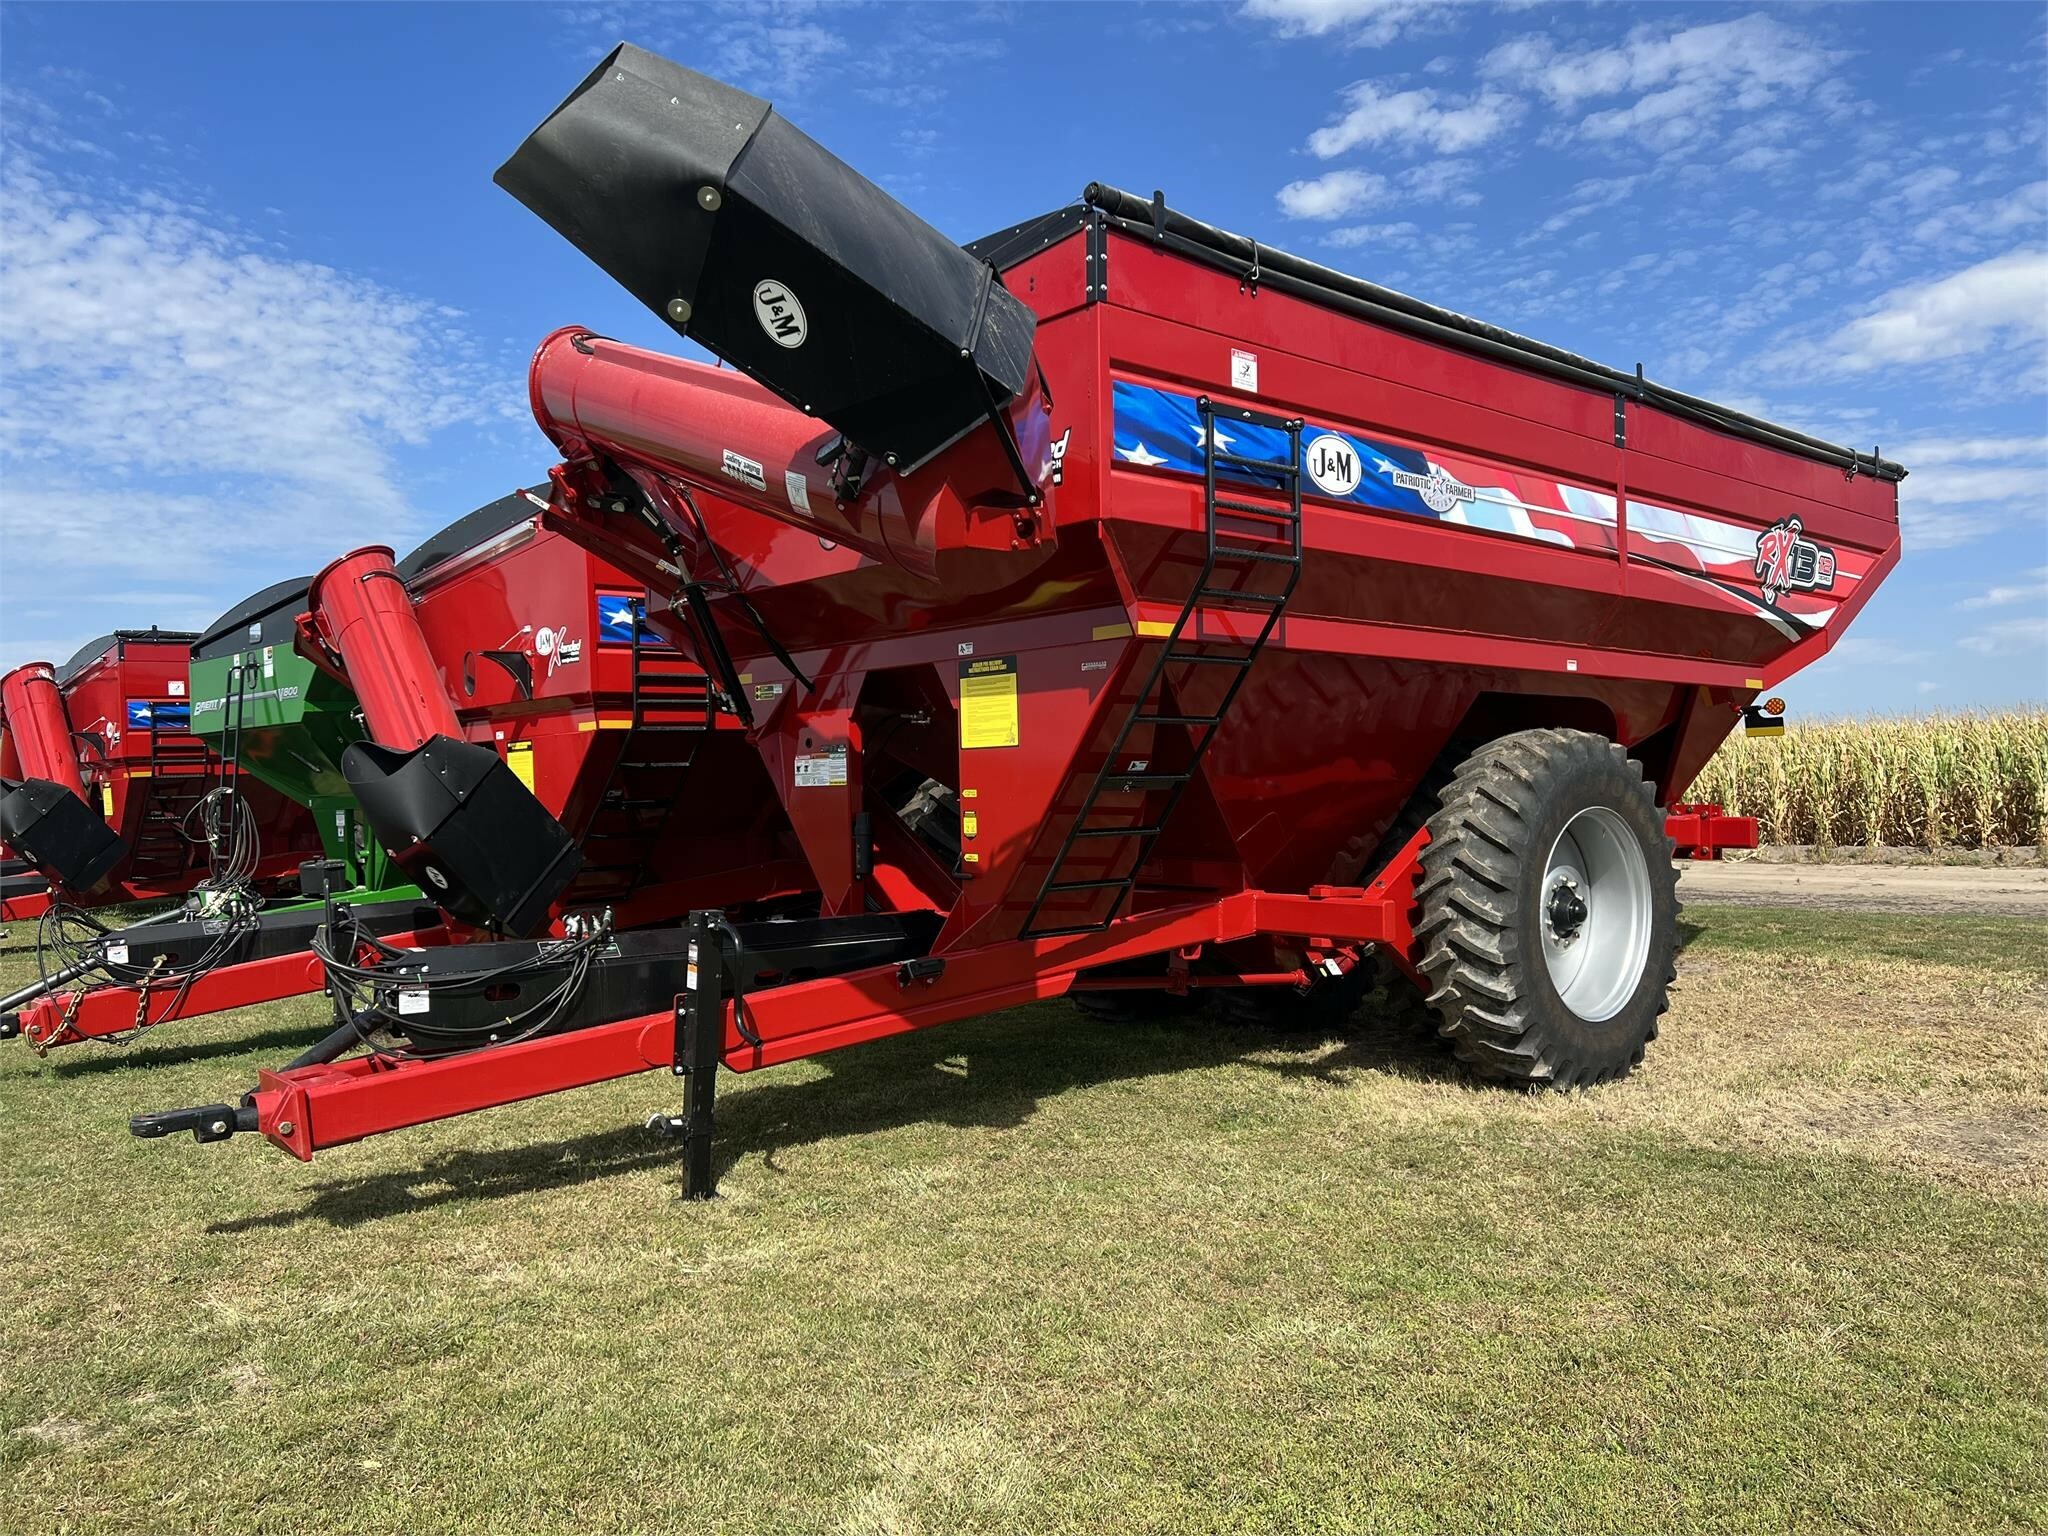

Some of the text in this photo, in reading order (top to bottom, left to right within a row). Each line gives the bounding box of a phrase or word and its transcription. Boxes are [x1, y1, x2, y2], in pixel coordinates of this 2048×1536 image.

[759, 286, 801, 339] J&M
[1313, 447, 1352, 483] J&M
[1396, 472, 1472, 498] PATRIOTIC FARMER
